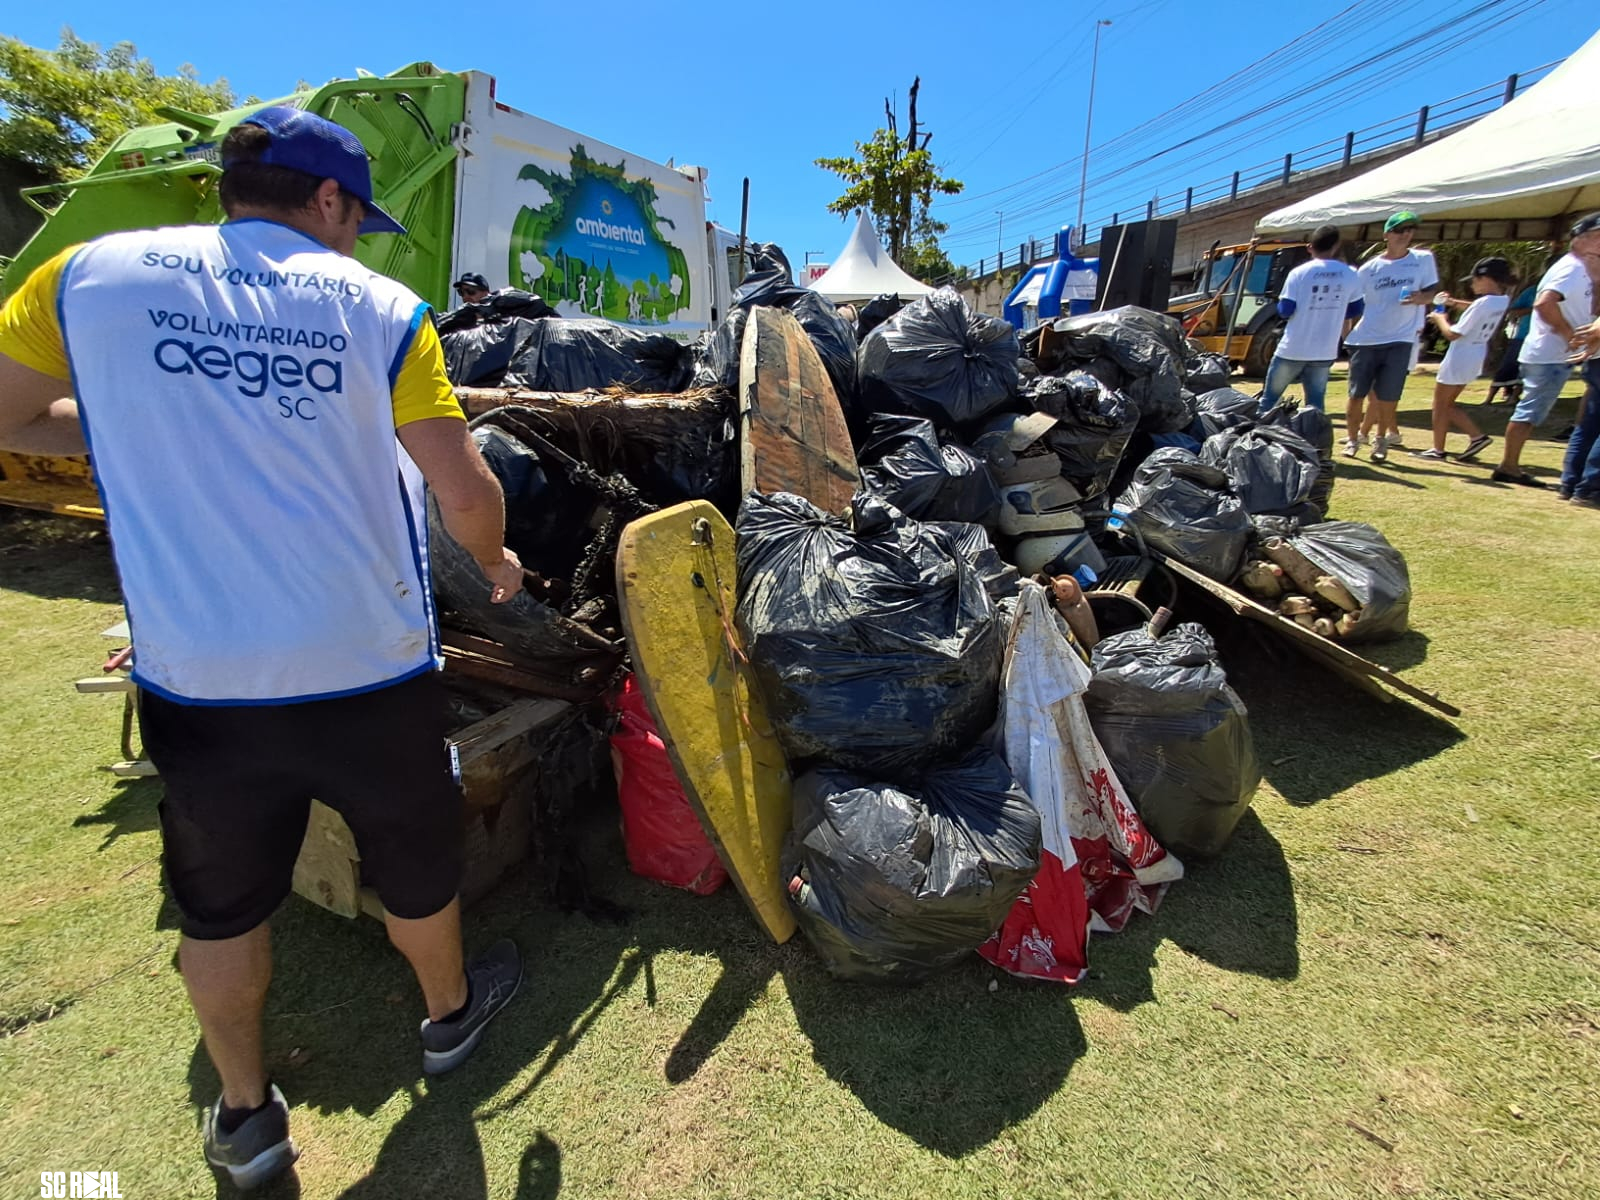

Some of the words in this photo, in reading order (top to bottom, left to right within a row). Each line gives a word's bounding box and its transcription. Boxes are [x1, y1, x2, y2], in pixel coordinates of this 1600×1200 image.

[576, 217, 646, 246] ambiental
[142, 252, 203, 274] SOU
[211, 264, 362, 297] VOLUNTÁRIO
[148, 308, 347, 352] VOLUNTARIADO
[154, 338, 343, 398] aegea
[278, 395, 317, 421] SC
